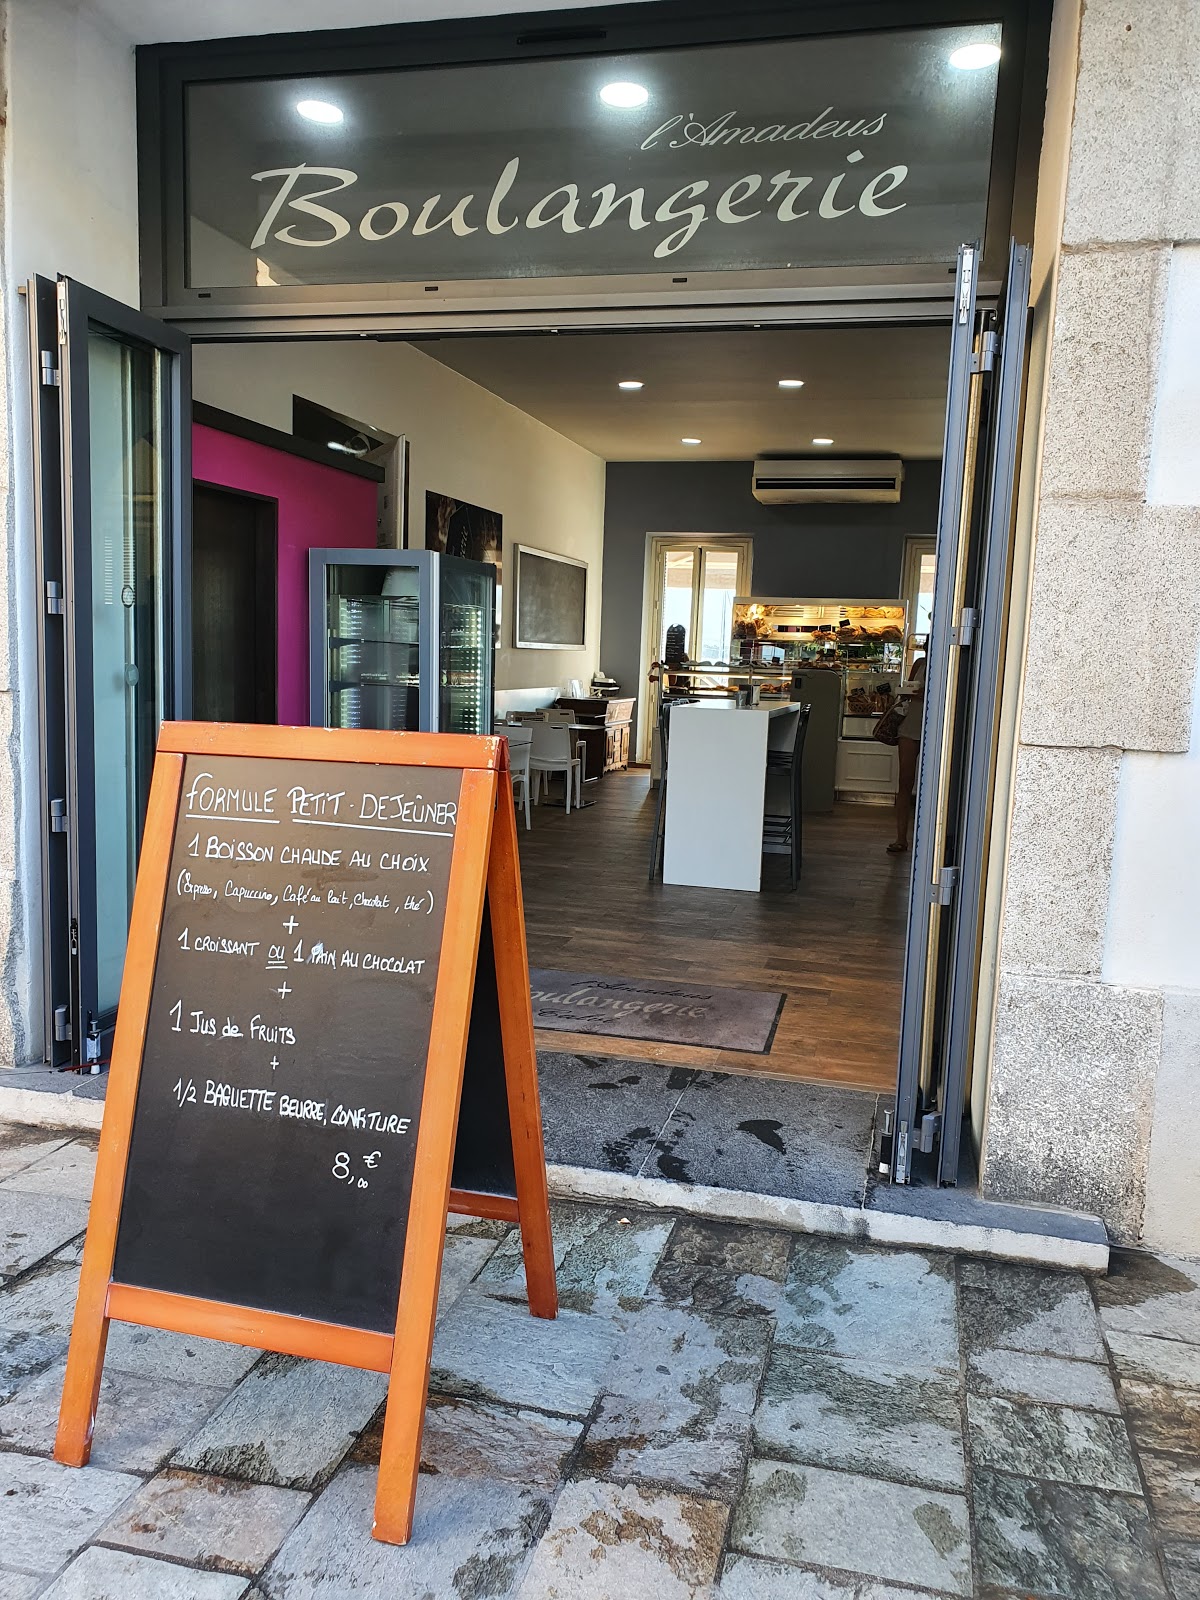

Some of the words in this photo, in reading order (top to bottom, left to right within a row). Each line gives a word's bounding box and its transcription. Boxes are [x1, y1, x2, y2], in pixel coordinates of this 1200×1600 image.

[251, 149, 909, 258] Boulangerie
[187, 832, 200, 857] 1
[279, 845, 343, 866] CHAUDE
[348, 850, 371, 868] AU
[177, 927, 191, 951] 1
[293, 939, 305, 963] 1
[340, 951, 359, 968] AU
[362, 953, 426, 975] CHOCOLAT
[169, 999, 182, 1033] 1
[530, 984, 707, 1018] oulangerie
[172, 1077, 197, 1108] 1/2
[203, 1079, 278, 1112] BAGUETTE
